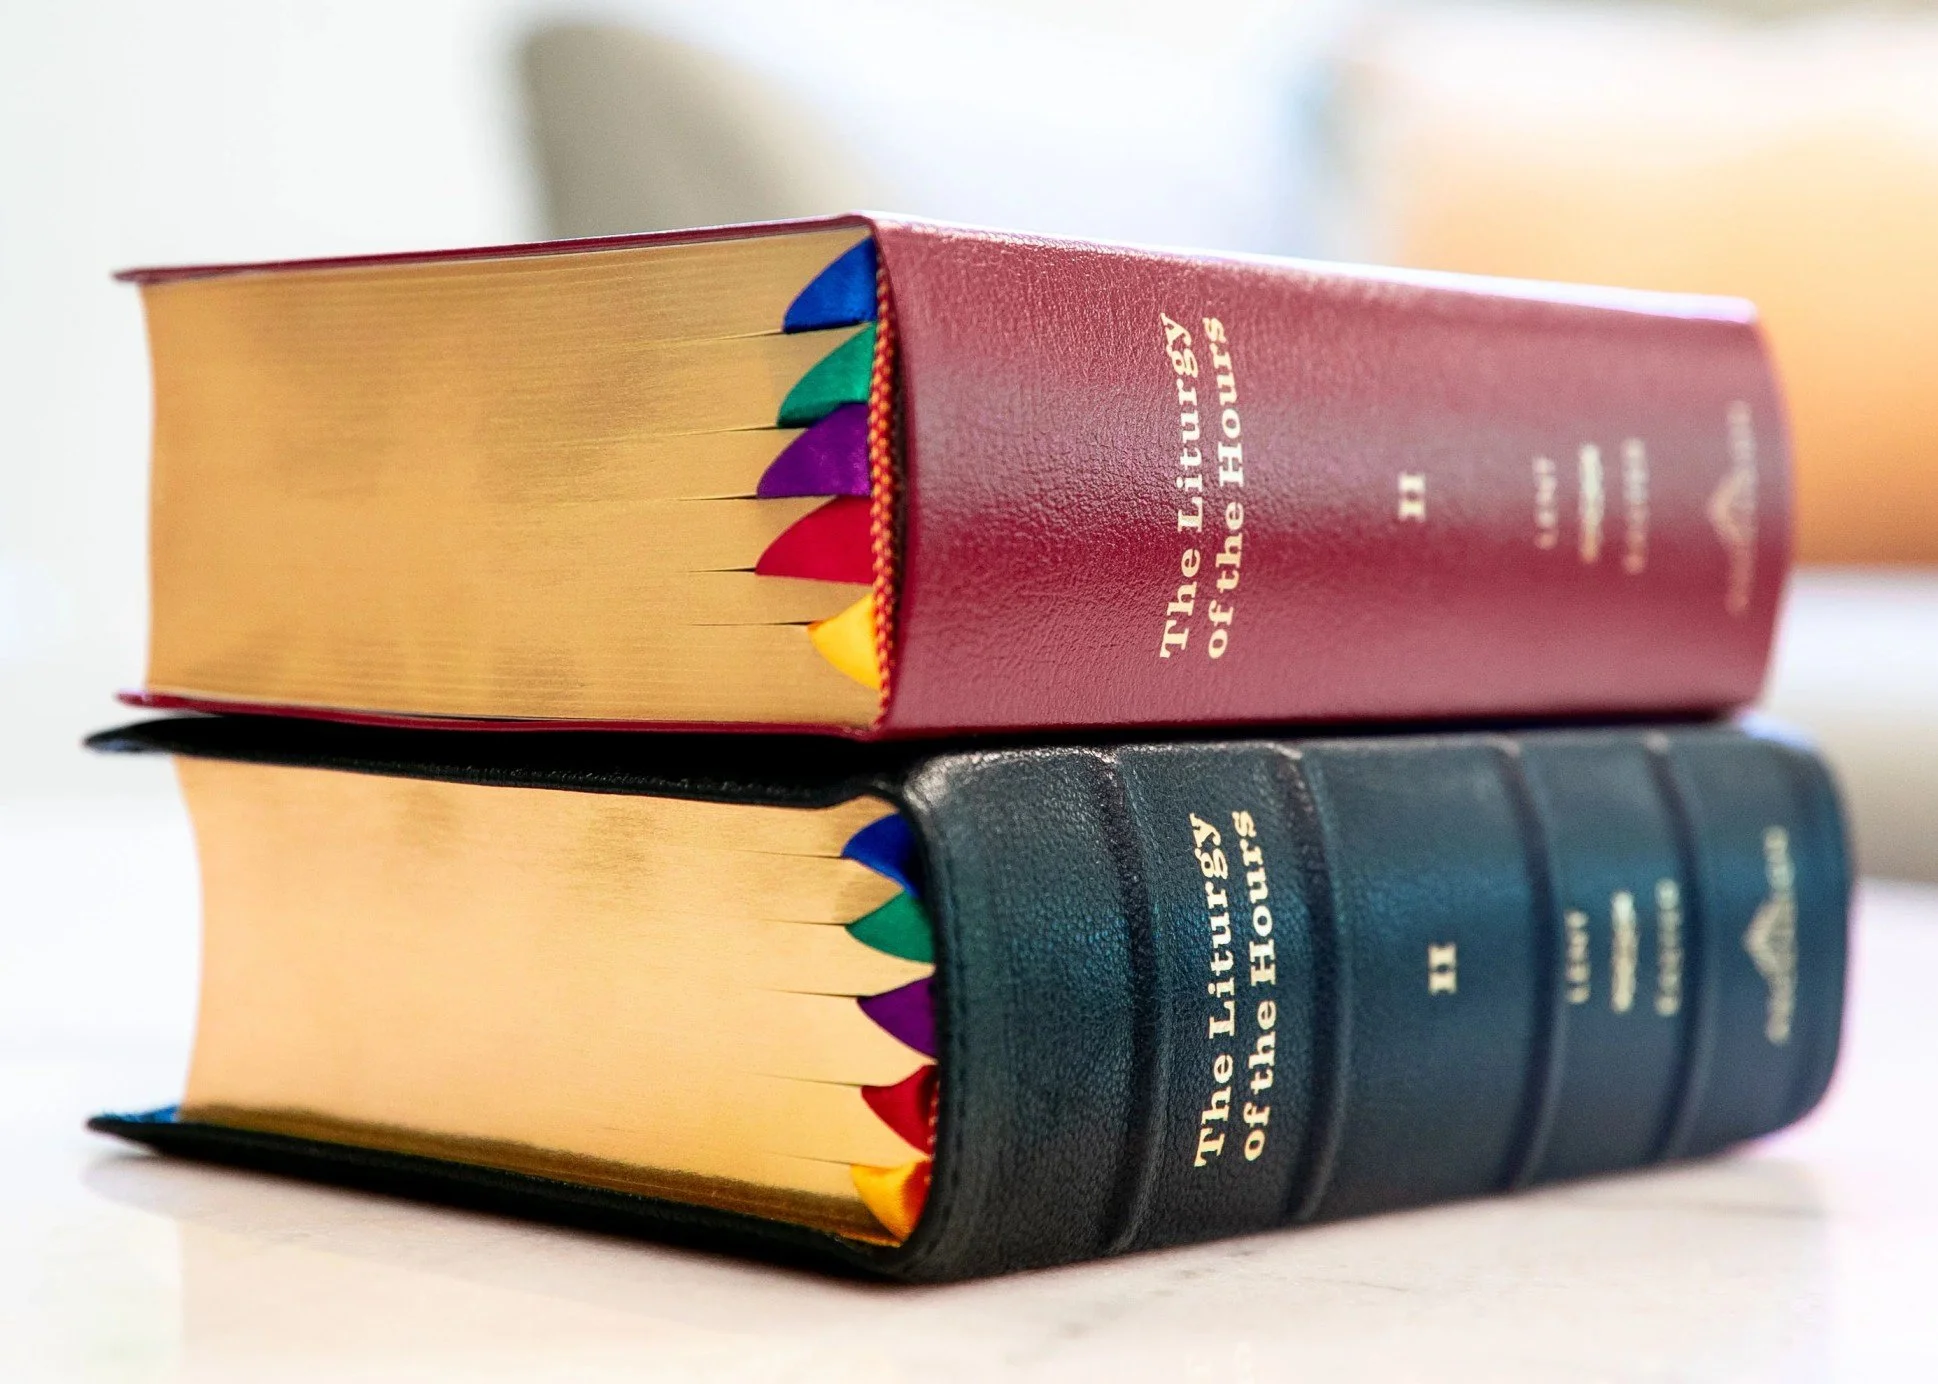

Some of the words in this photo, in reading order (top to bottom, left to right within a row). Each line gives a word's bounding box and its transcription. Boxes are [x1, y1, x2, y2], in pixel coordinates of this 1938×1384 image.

[1160, 312, 1203, 533] Liturgy
[1202, 317, 1245, 488] Hours
[1215, 502, 1245, 593] the
[1398, 472, 1426, 522] II
[1160, 549, 1200, 658] The
[1207, 600, 1234, 659] of
[1190, 813, 1236, 1039] Liturgy
[1231, 810, 1277, 986] Hours
[1428, 942, 1457, 995] II
[1248, 1000, 1277, 1095] the
[1194, 1054, 1234, 1167] The
[1243, 1102, 1271, 1161] of
